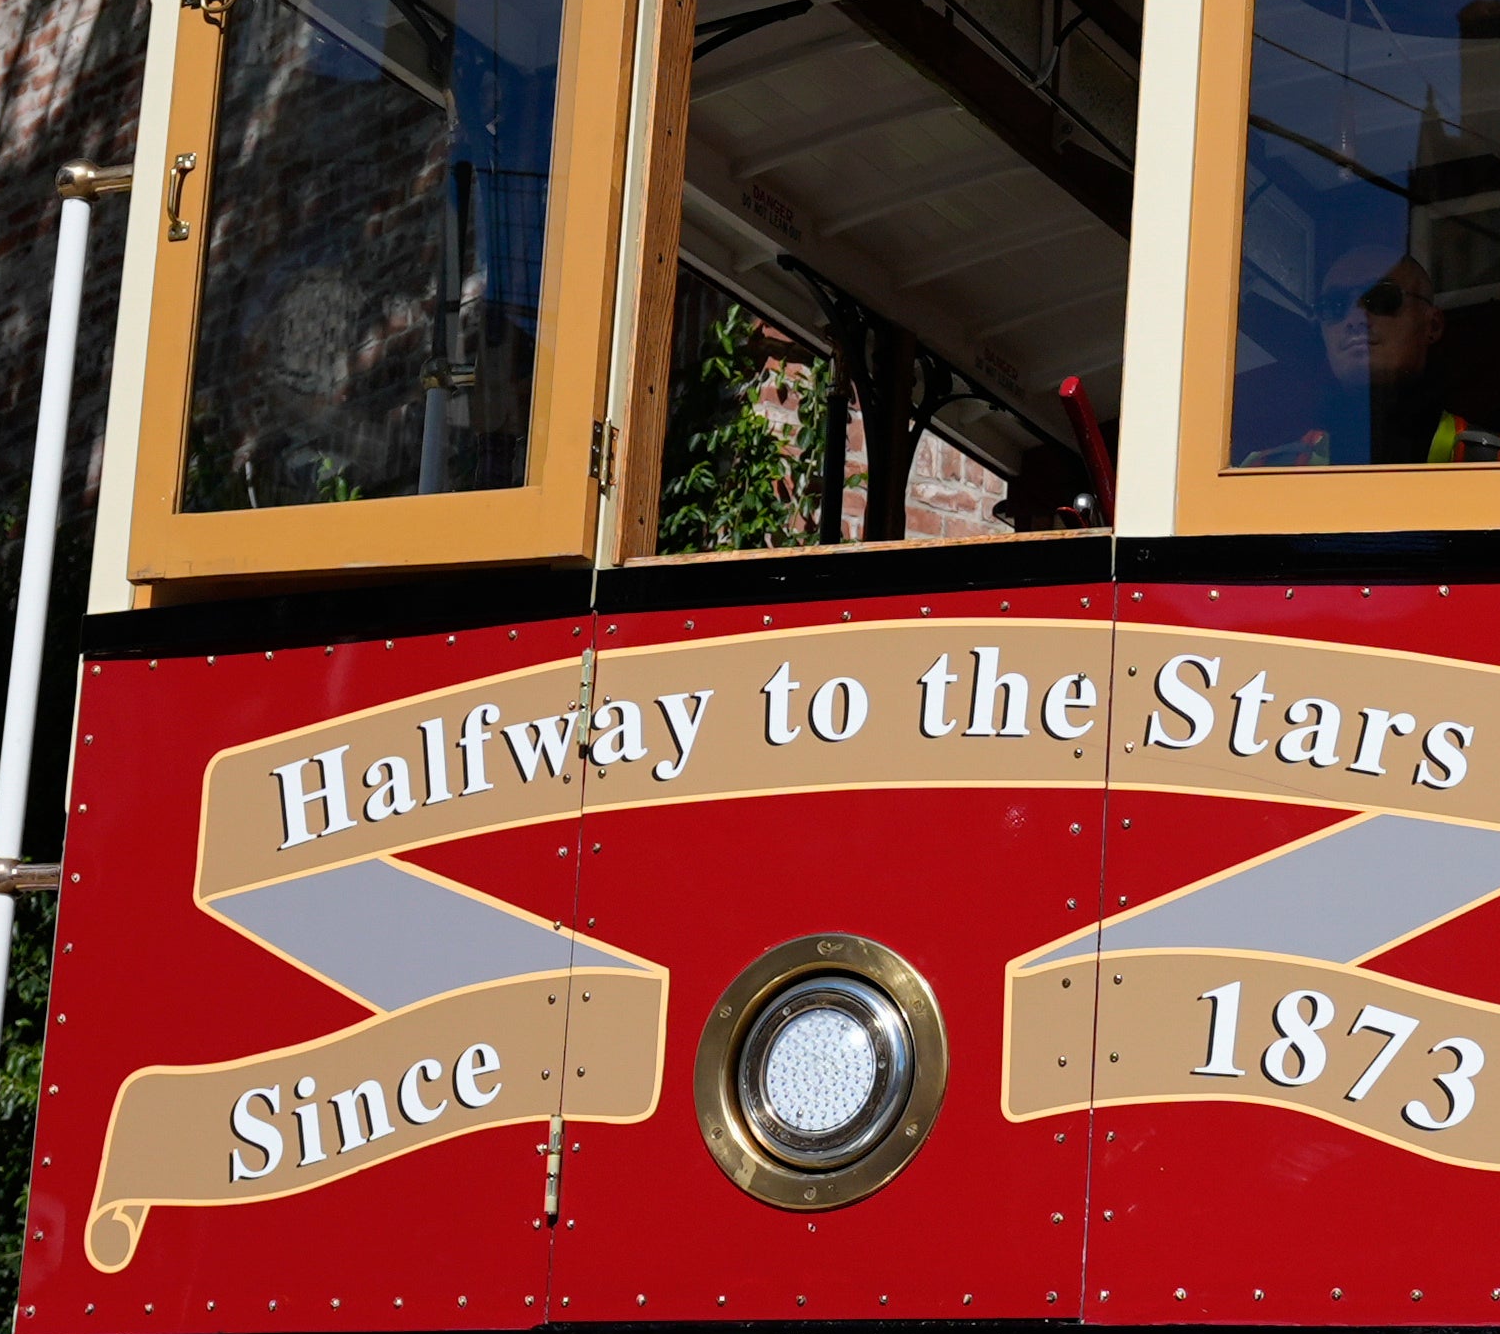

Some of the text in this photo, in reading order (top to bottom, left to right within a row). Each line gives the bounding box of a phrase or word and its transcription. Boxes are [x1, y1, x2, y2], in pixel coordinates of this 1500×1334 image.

[272, 646, 1475, 851] Halfway to the Stars
[229, 1042, 501, 1184] Since
[1192, 980, 1485, 1131] 1873
